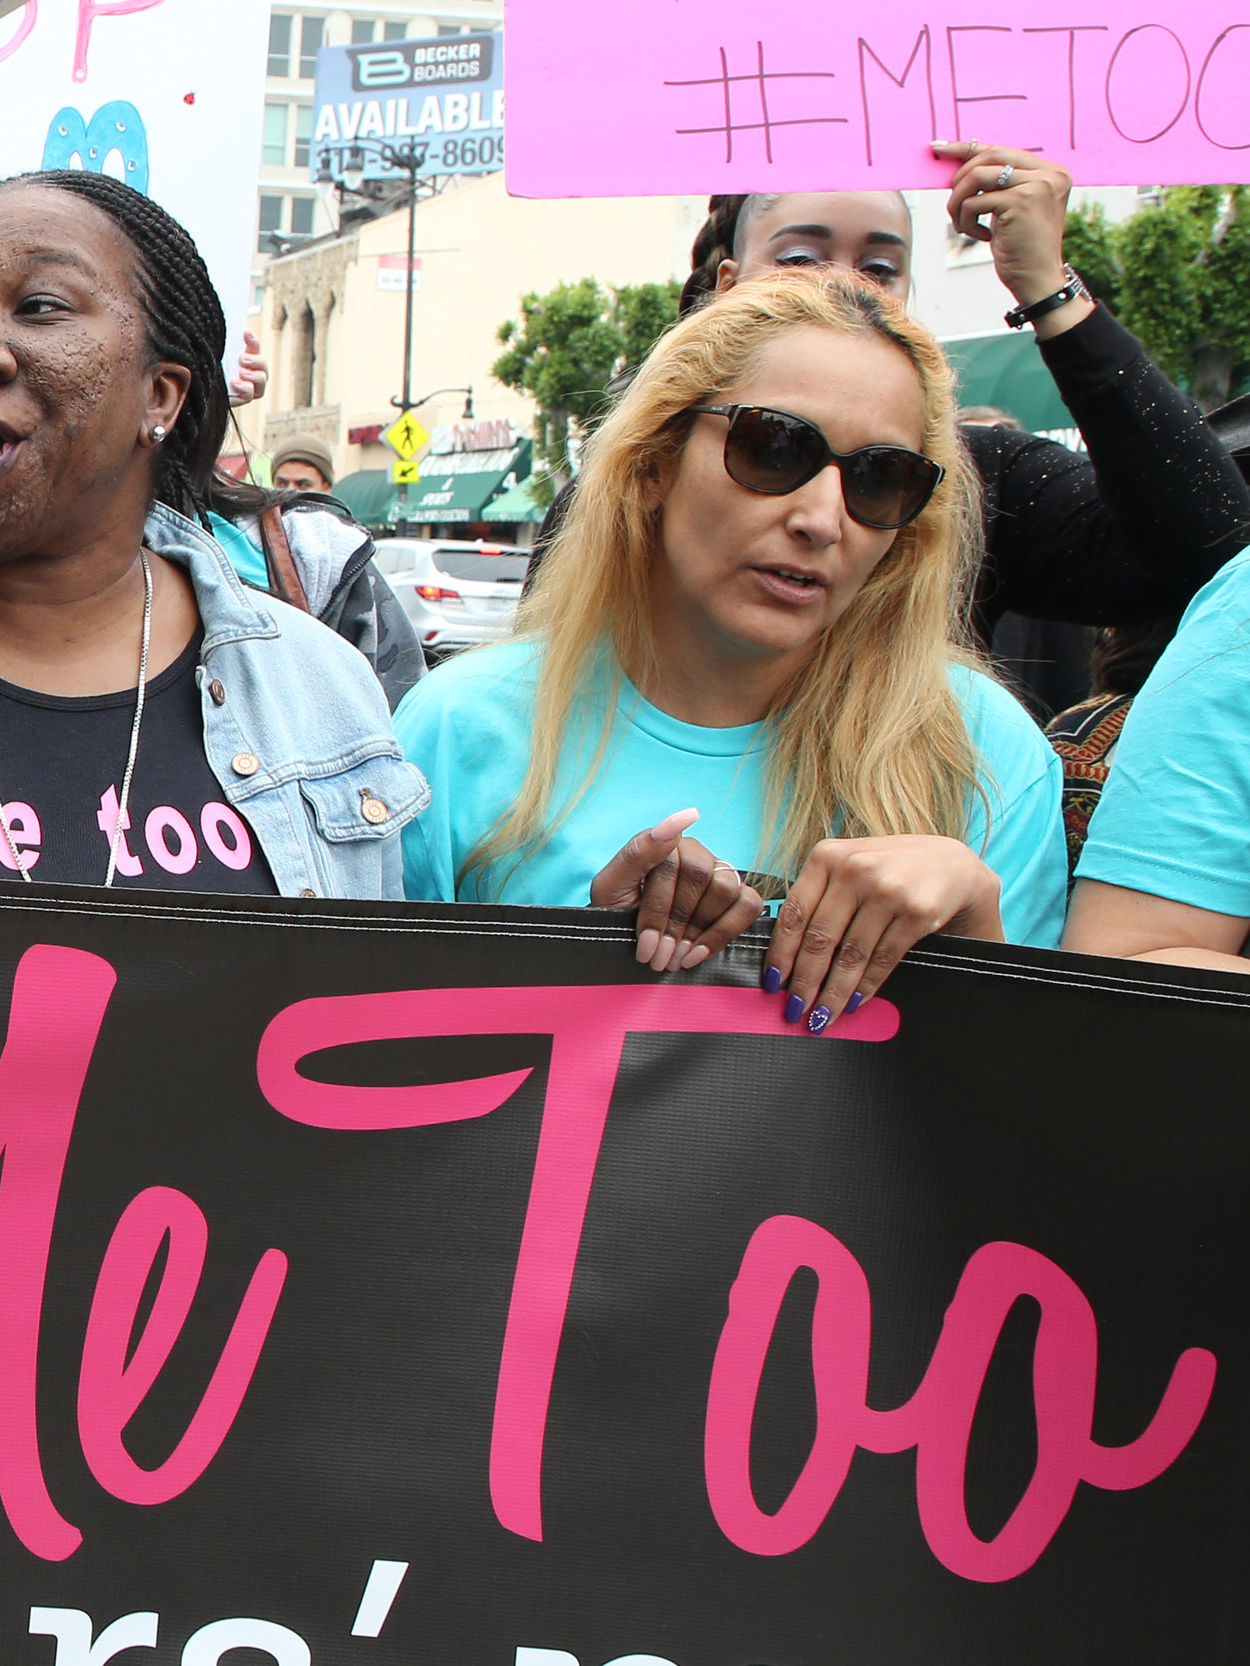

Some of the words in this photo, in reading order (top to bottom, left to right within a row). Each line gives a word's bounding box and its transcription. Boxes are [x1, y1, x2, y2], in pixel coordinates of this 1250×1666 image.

[413, 61, 481, 83] BOARDS
[414, 43, 482, 65] BECKER
[315, 89, 504, 142] AVAILABLE
[664, 24, 1250, 167] #METOO
[96, 783, 252, 877] too
